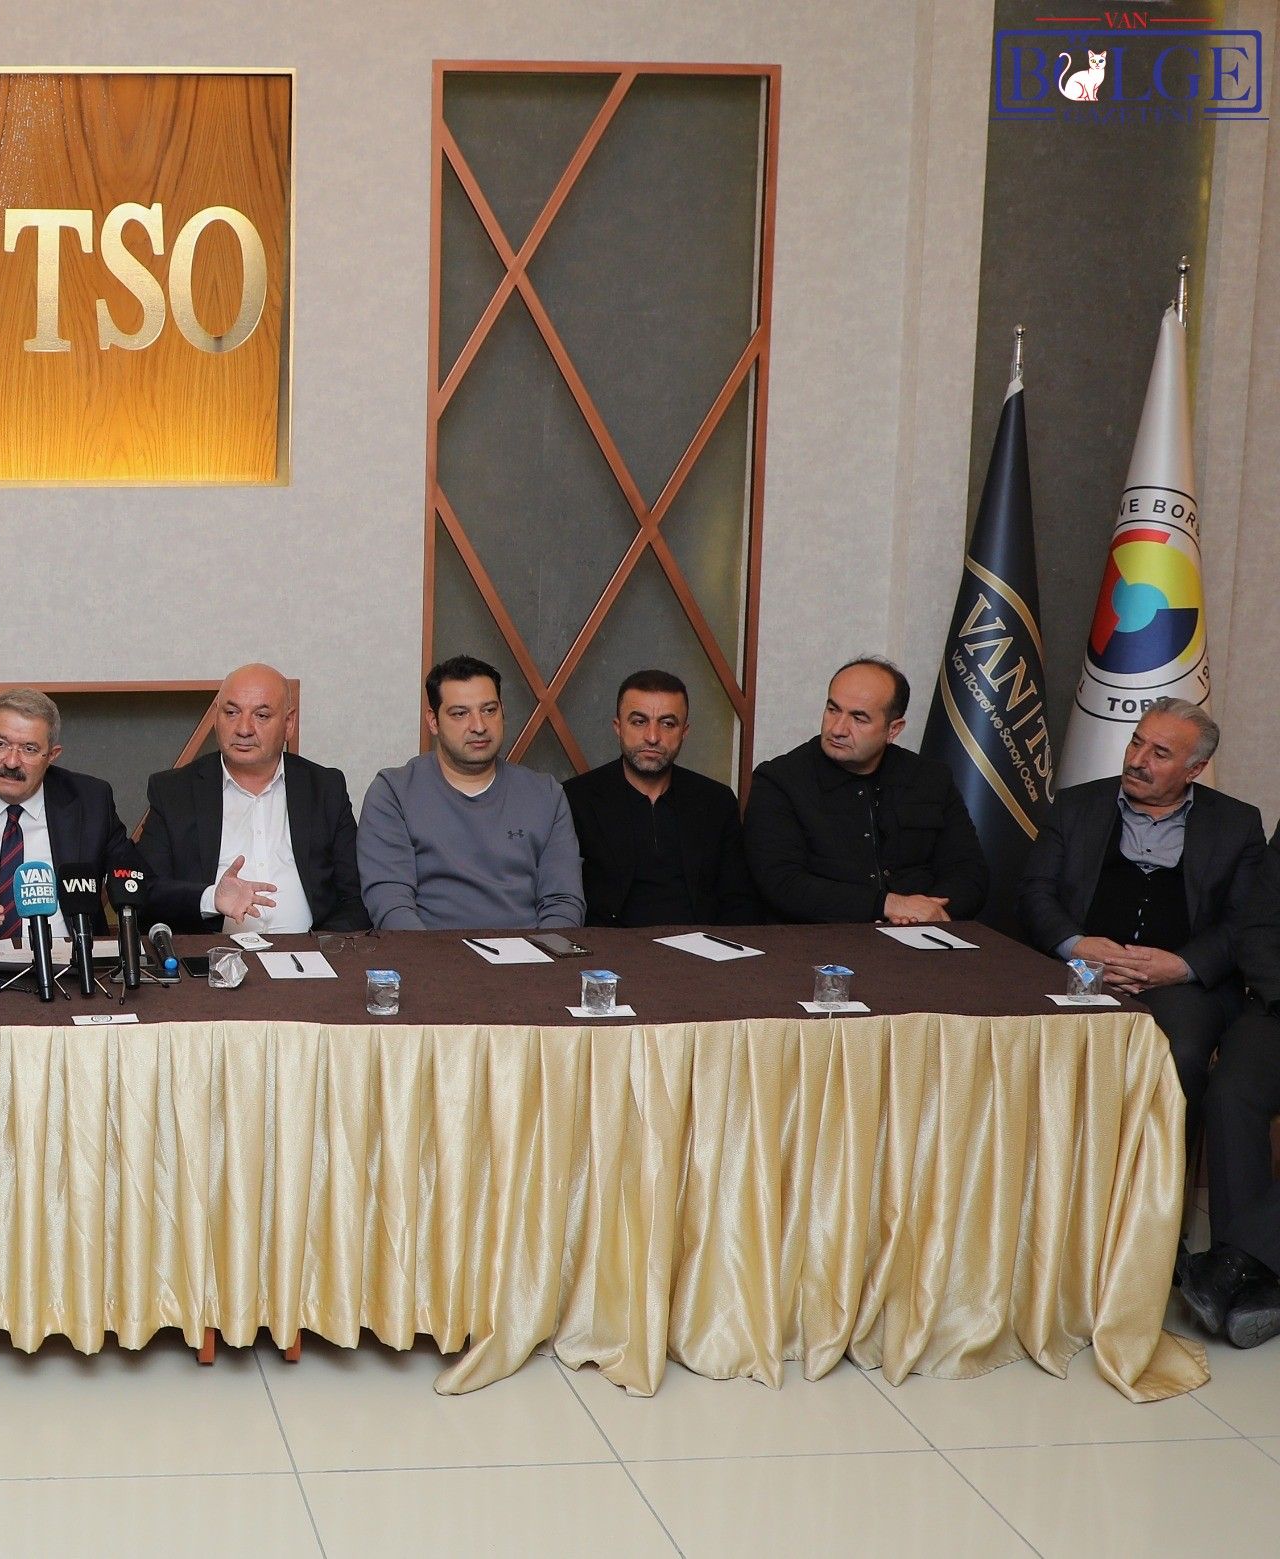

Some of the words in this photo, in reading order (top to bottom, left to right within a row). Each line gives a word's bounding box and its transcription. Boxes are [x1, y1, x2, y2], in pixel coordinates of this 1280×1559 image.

[4, 202, 268, 353] TSO
[959, 593, 1038, 711] VAN
[952, 649, 967, 676] Van
[989, 711, 1004, 729] ve
[1107, 696, 1170, 714] TOB
[20, 868, 53, 884] VAN
[20, 886, 54, 898] HABER
[62, 878, 92, 893] VAN
